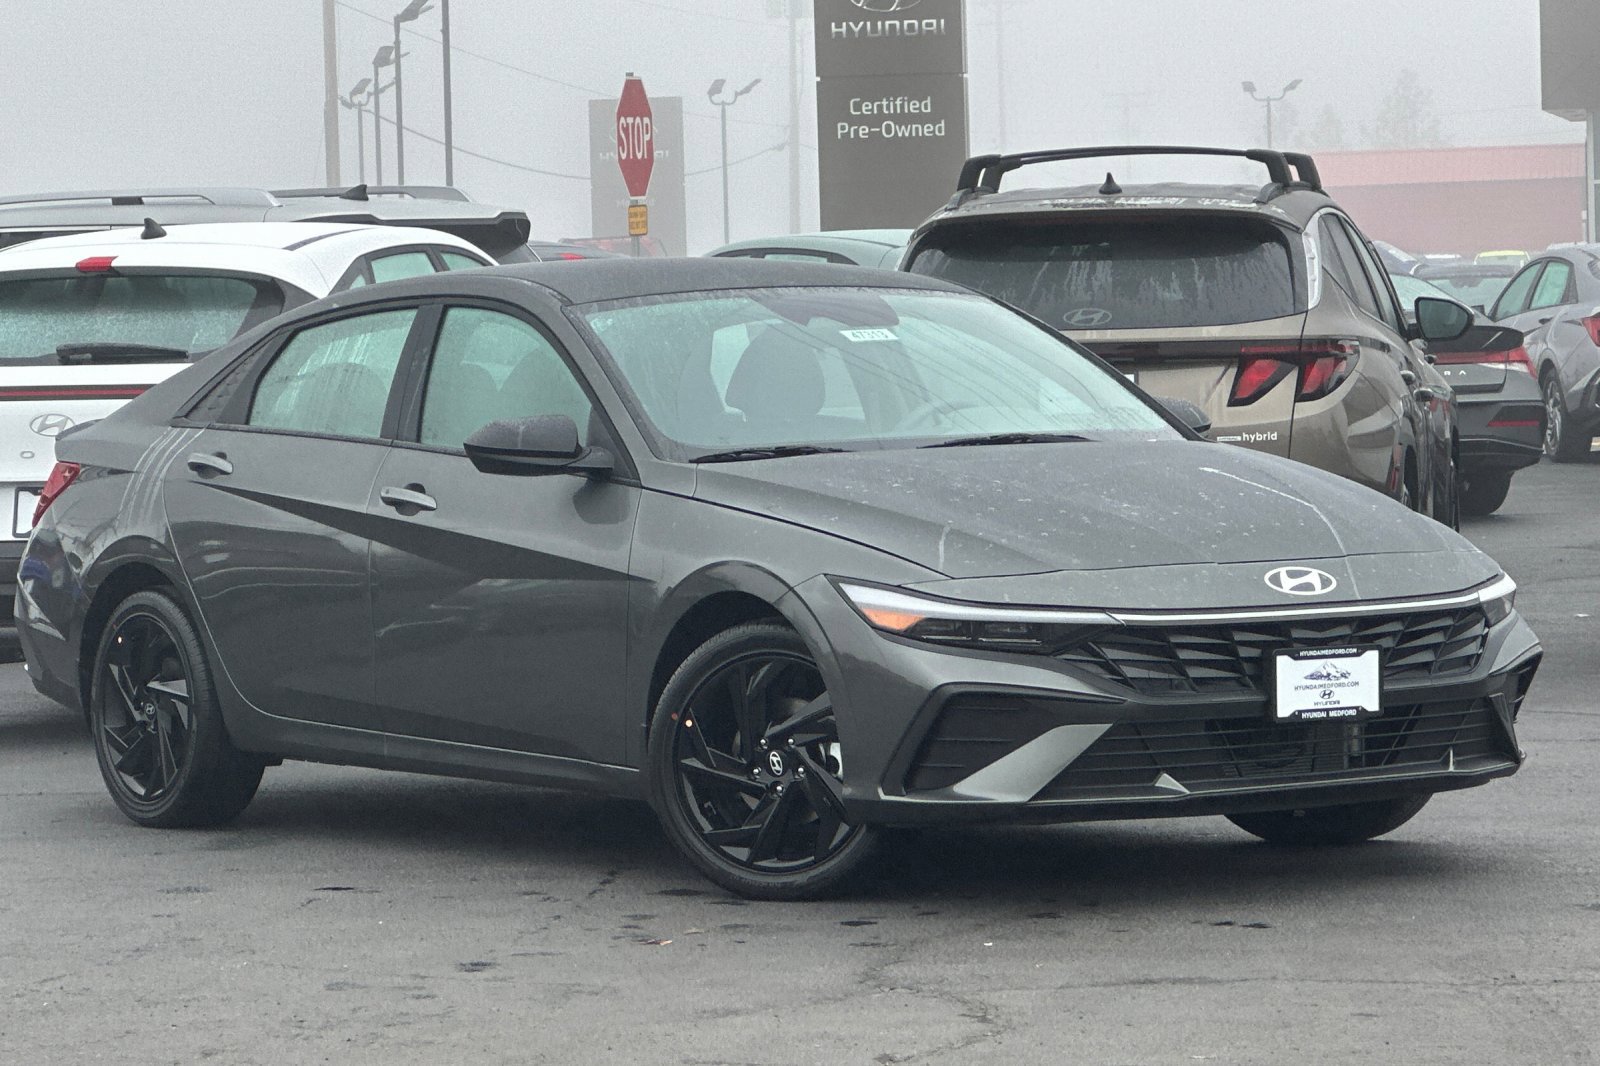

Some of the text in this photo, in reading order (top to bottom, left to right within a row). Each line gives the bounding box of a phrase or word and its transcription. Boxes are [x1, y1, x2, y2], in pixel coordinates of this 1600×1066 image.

[831, 19, 945, 38] HYUNDAI
[849, 96, 931, 115] Certified
[837, 120, 945, 139] Pre-Owned
[619, 116, 651, 160] STOP
[1242, 431, 1278, 443] hybrid
[1300, 648, 1357, 656] HYUNDAIMEDFORD.COM
[1294, 681, 1359, 690] HYUNDAIMEDFORD.COM
[1301, 708, 1357, 719] HYUNDAI MEDFORD
